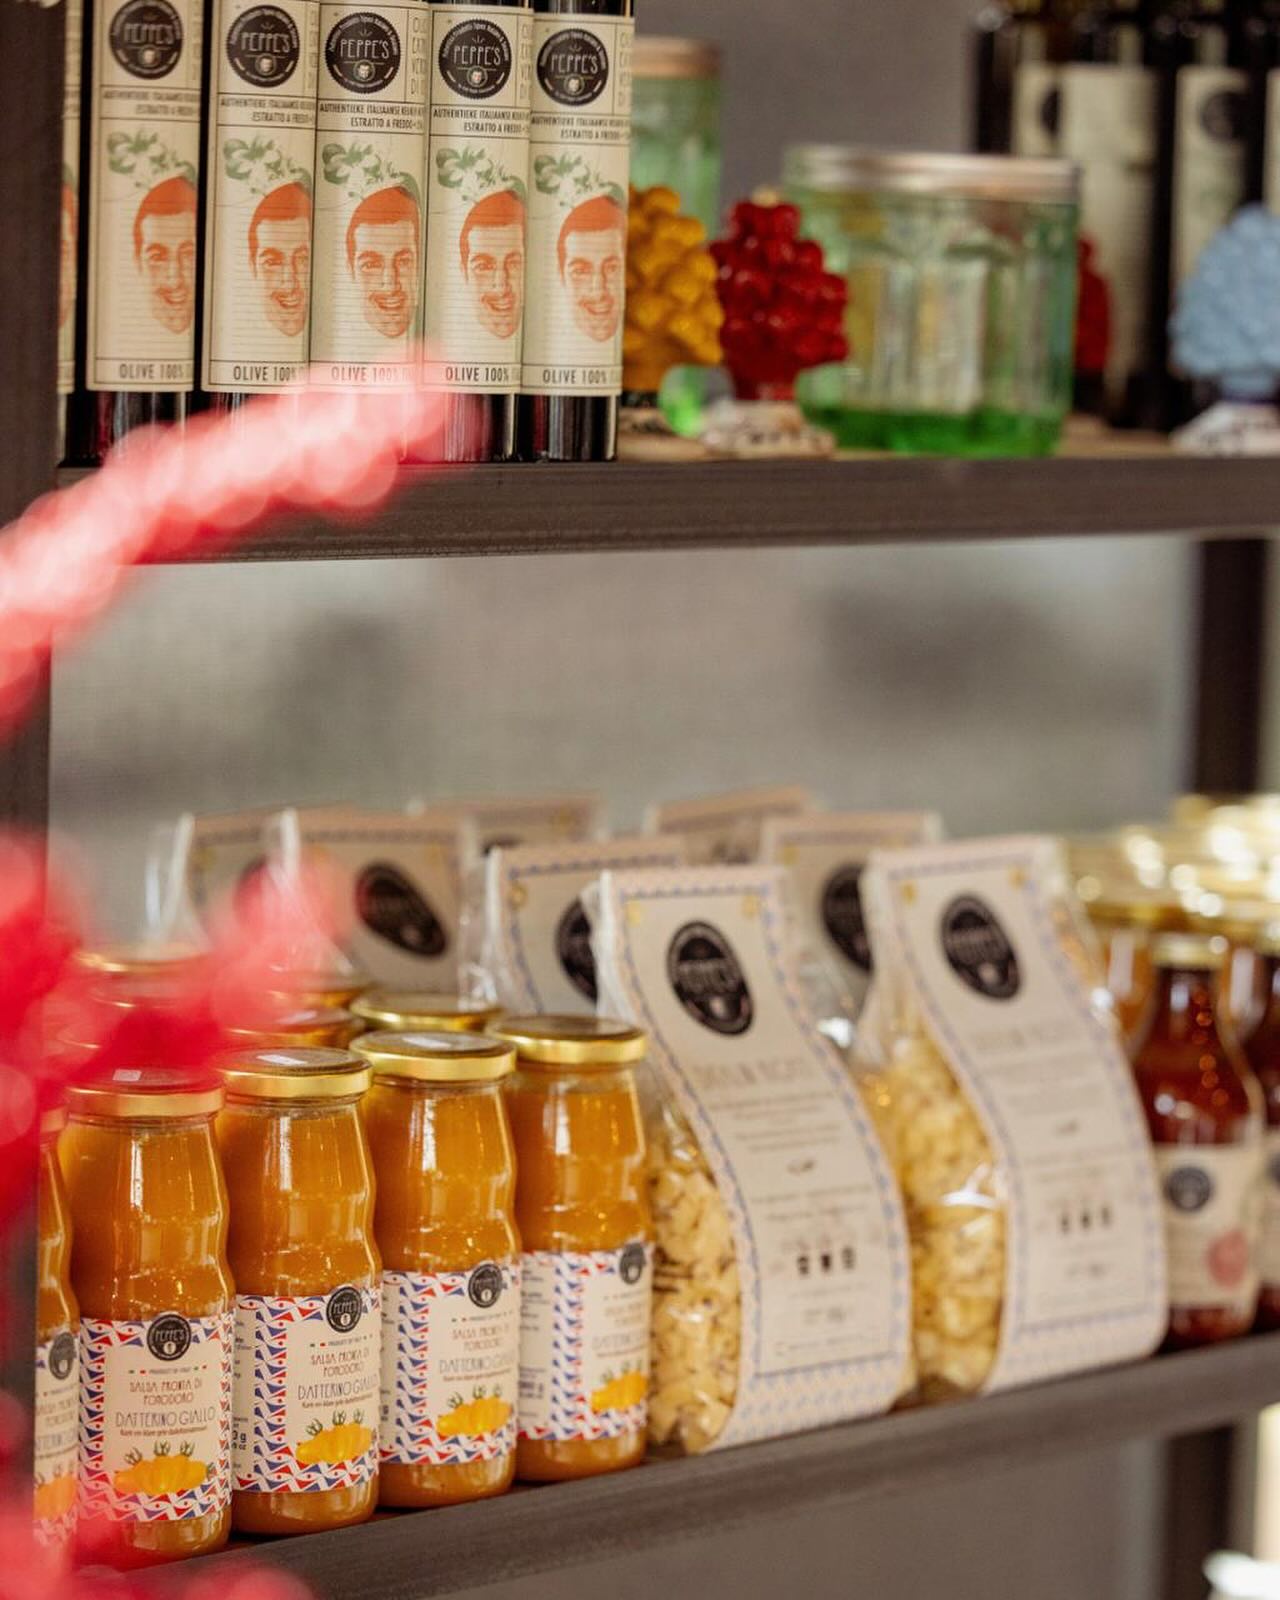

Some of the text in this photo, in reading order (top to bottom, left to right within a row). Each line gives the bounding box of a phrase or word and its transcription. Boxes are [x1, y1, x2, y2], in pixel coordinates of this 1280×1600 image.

[241, 32, 291, 53] PEPPE'S
[340, 39, 389, 59] PEPPE'S
[453, 45, 501, 66] PEPPE'S
[550, 54, 598, 74] PEPPE'S
[320, 103, 364, 114] AUTHENTIEKE
[433, 109, 477, 119] AUTHENTIEKE
[351, 117, 384, 128] ESTRATTO
[464, 122, 497, 132] ESTRATTO
[119, 363, 154, 379] OLIVE
[233, 366, 270, 381] OLIVE
[331, 366, 366, 381] OLIVE
[445, 367, 509, 382] OLIVE 100%
[543, 369, 575, 384] OLIVE
[115, 1411, 177, 1428] DATTERINO
[179, 1406, 216, 1426] GIALLO
